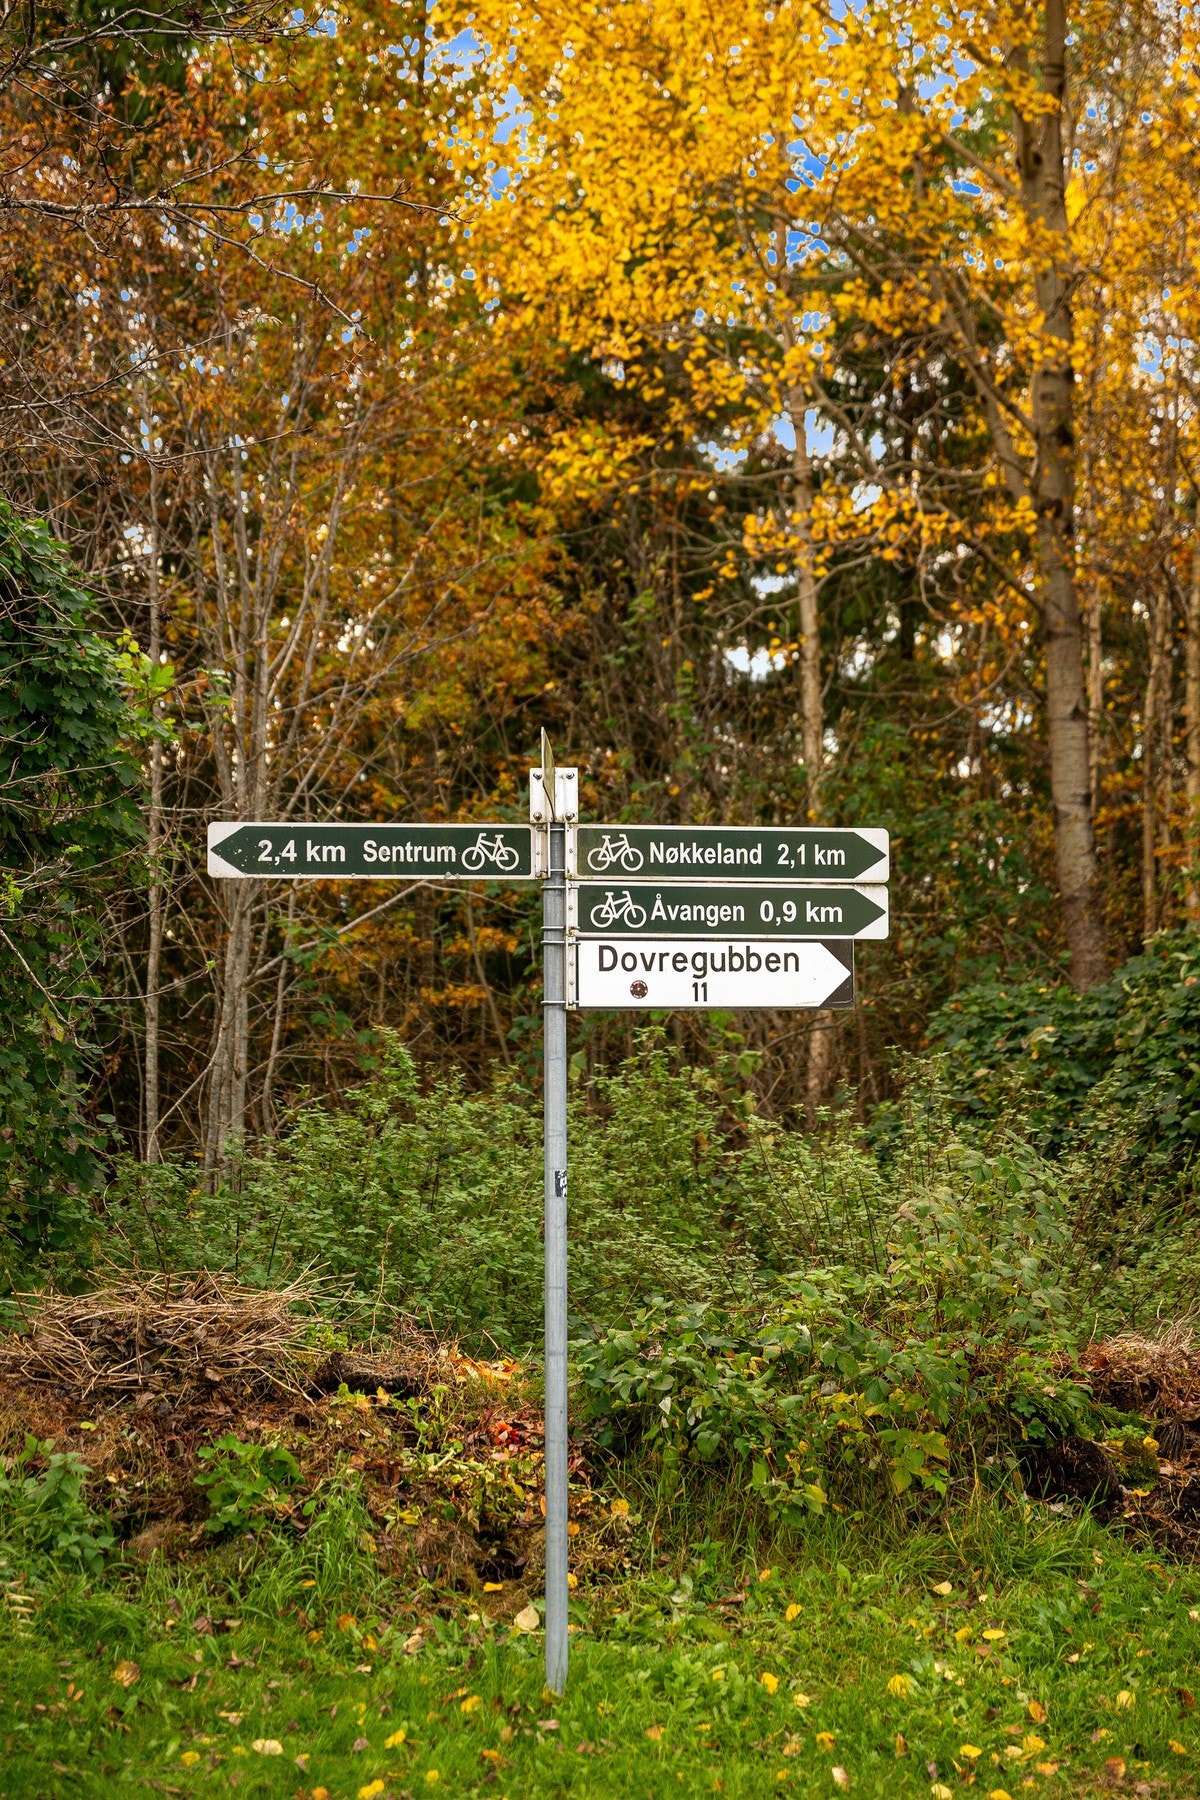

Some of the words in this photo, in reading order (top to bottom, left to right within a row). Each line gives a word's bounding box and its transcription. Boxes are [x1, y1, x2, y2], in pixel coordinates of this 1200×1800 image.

[258, 840, 297, 866] 2,4
[306, 840, 346, 861] km
[363, 840, 456, 862] Sentrum
[650, 842, 762, 865] Nøkkeland
[777, 844, 807, 869] 2,1
[814, 844, 846, 865] km
[650, 893, 745, 927] Åvangen
[759, 901, 797, 926] 0,9
[806, 901, 843, 923] km
[598, 945, 800, 979] Dovregubben
[692, 982, 708, 1002] 11
